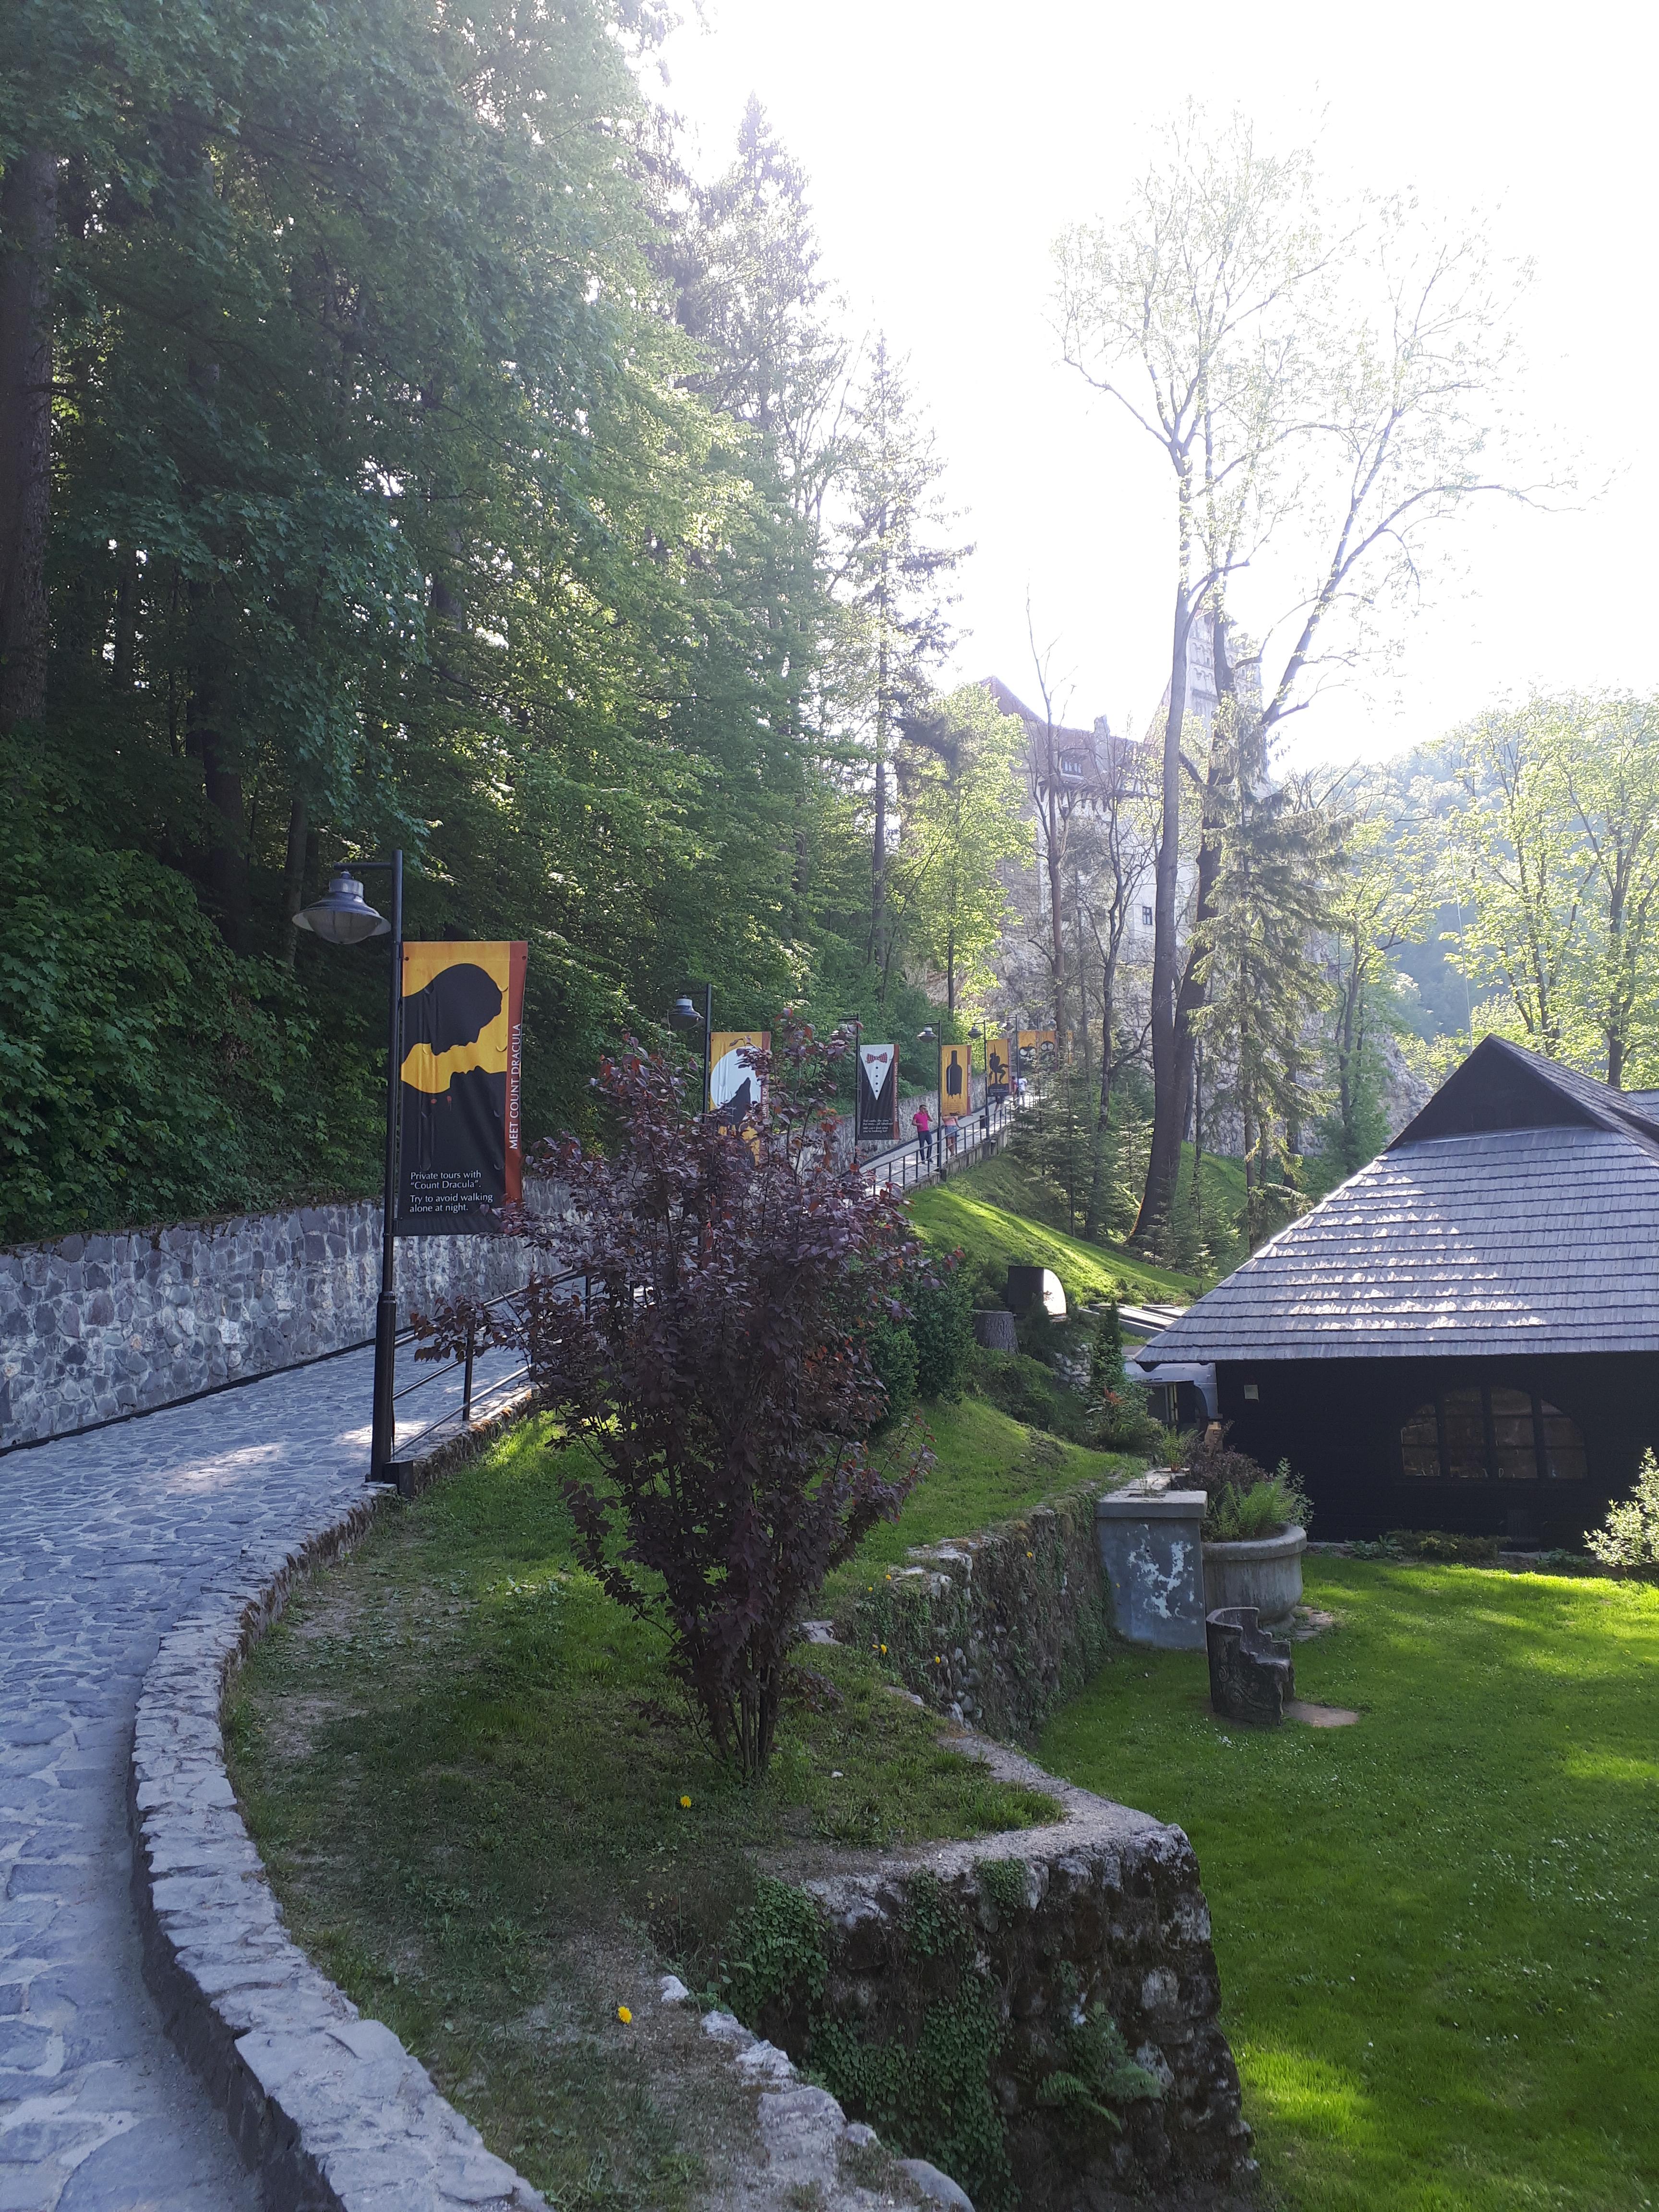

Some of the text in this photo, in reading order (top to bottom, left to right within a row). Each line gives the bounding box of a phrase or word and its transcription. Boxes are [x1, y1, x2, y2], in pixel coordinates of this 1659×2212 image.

[509, 1023, 521, 1149] MEET COUNT DRACULA
[410, 1172, 438, 1180] Private
[463, 1170, 481, 1178] with
[409, 1195, 422, 1205] Try
[435, 1193, 458, 1202] avoid
[460, 1192, 493, 1203] walking
[409, 1204, 433, 1213] alone
[445, 1202, 469, 1214] night.
